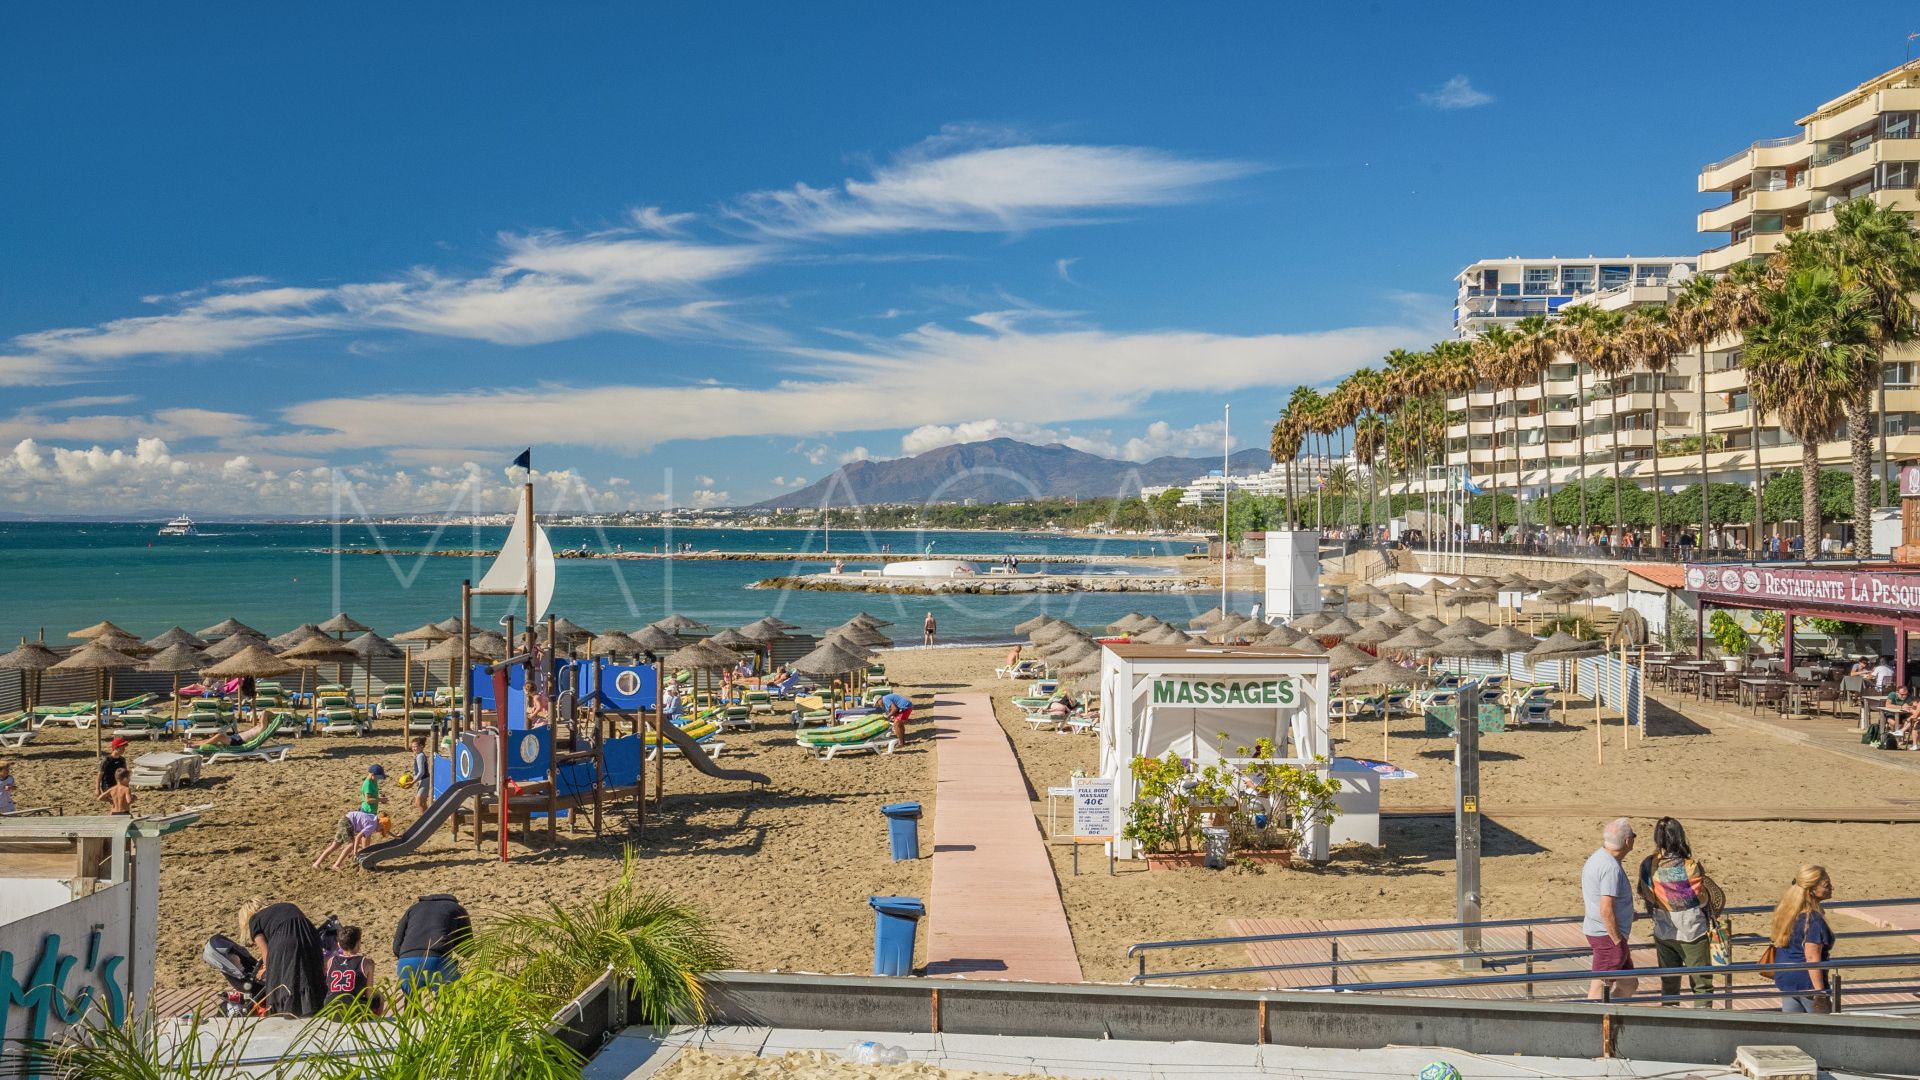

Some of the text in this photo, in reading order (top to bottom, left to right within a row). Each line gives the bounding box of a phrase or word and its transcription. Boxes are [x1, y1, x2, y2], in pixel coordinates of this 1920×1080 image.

[1871, 579, 1920, 608] PESQU
[1153, 680, 1294, 704] MASSAGES
[1084, 798, 1104, 806] 40€
[331, 970, 356, 992] 23
